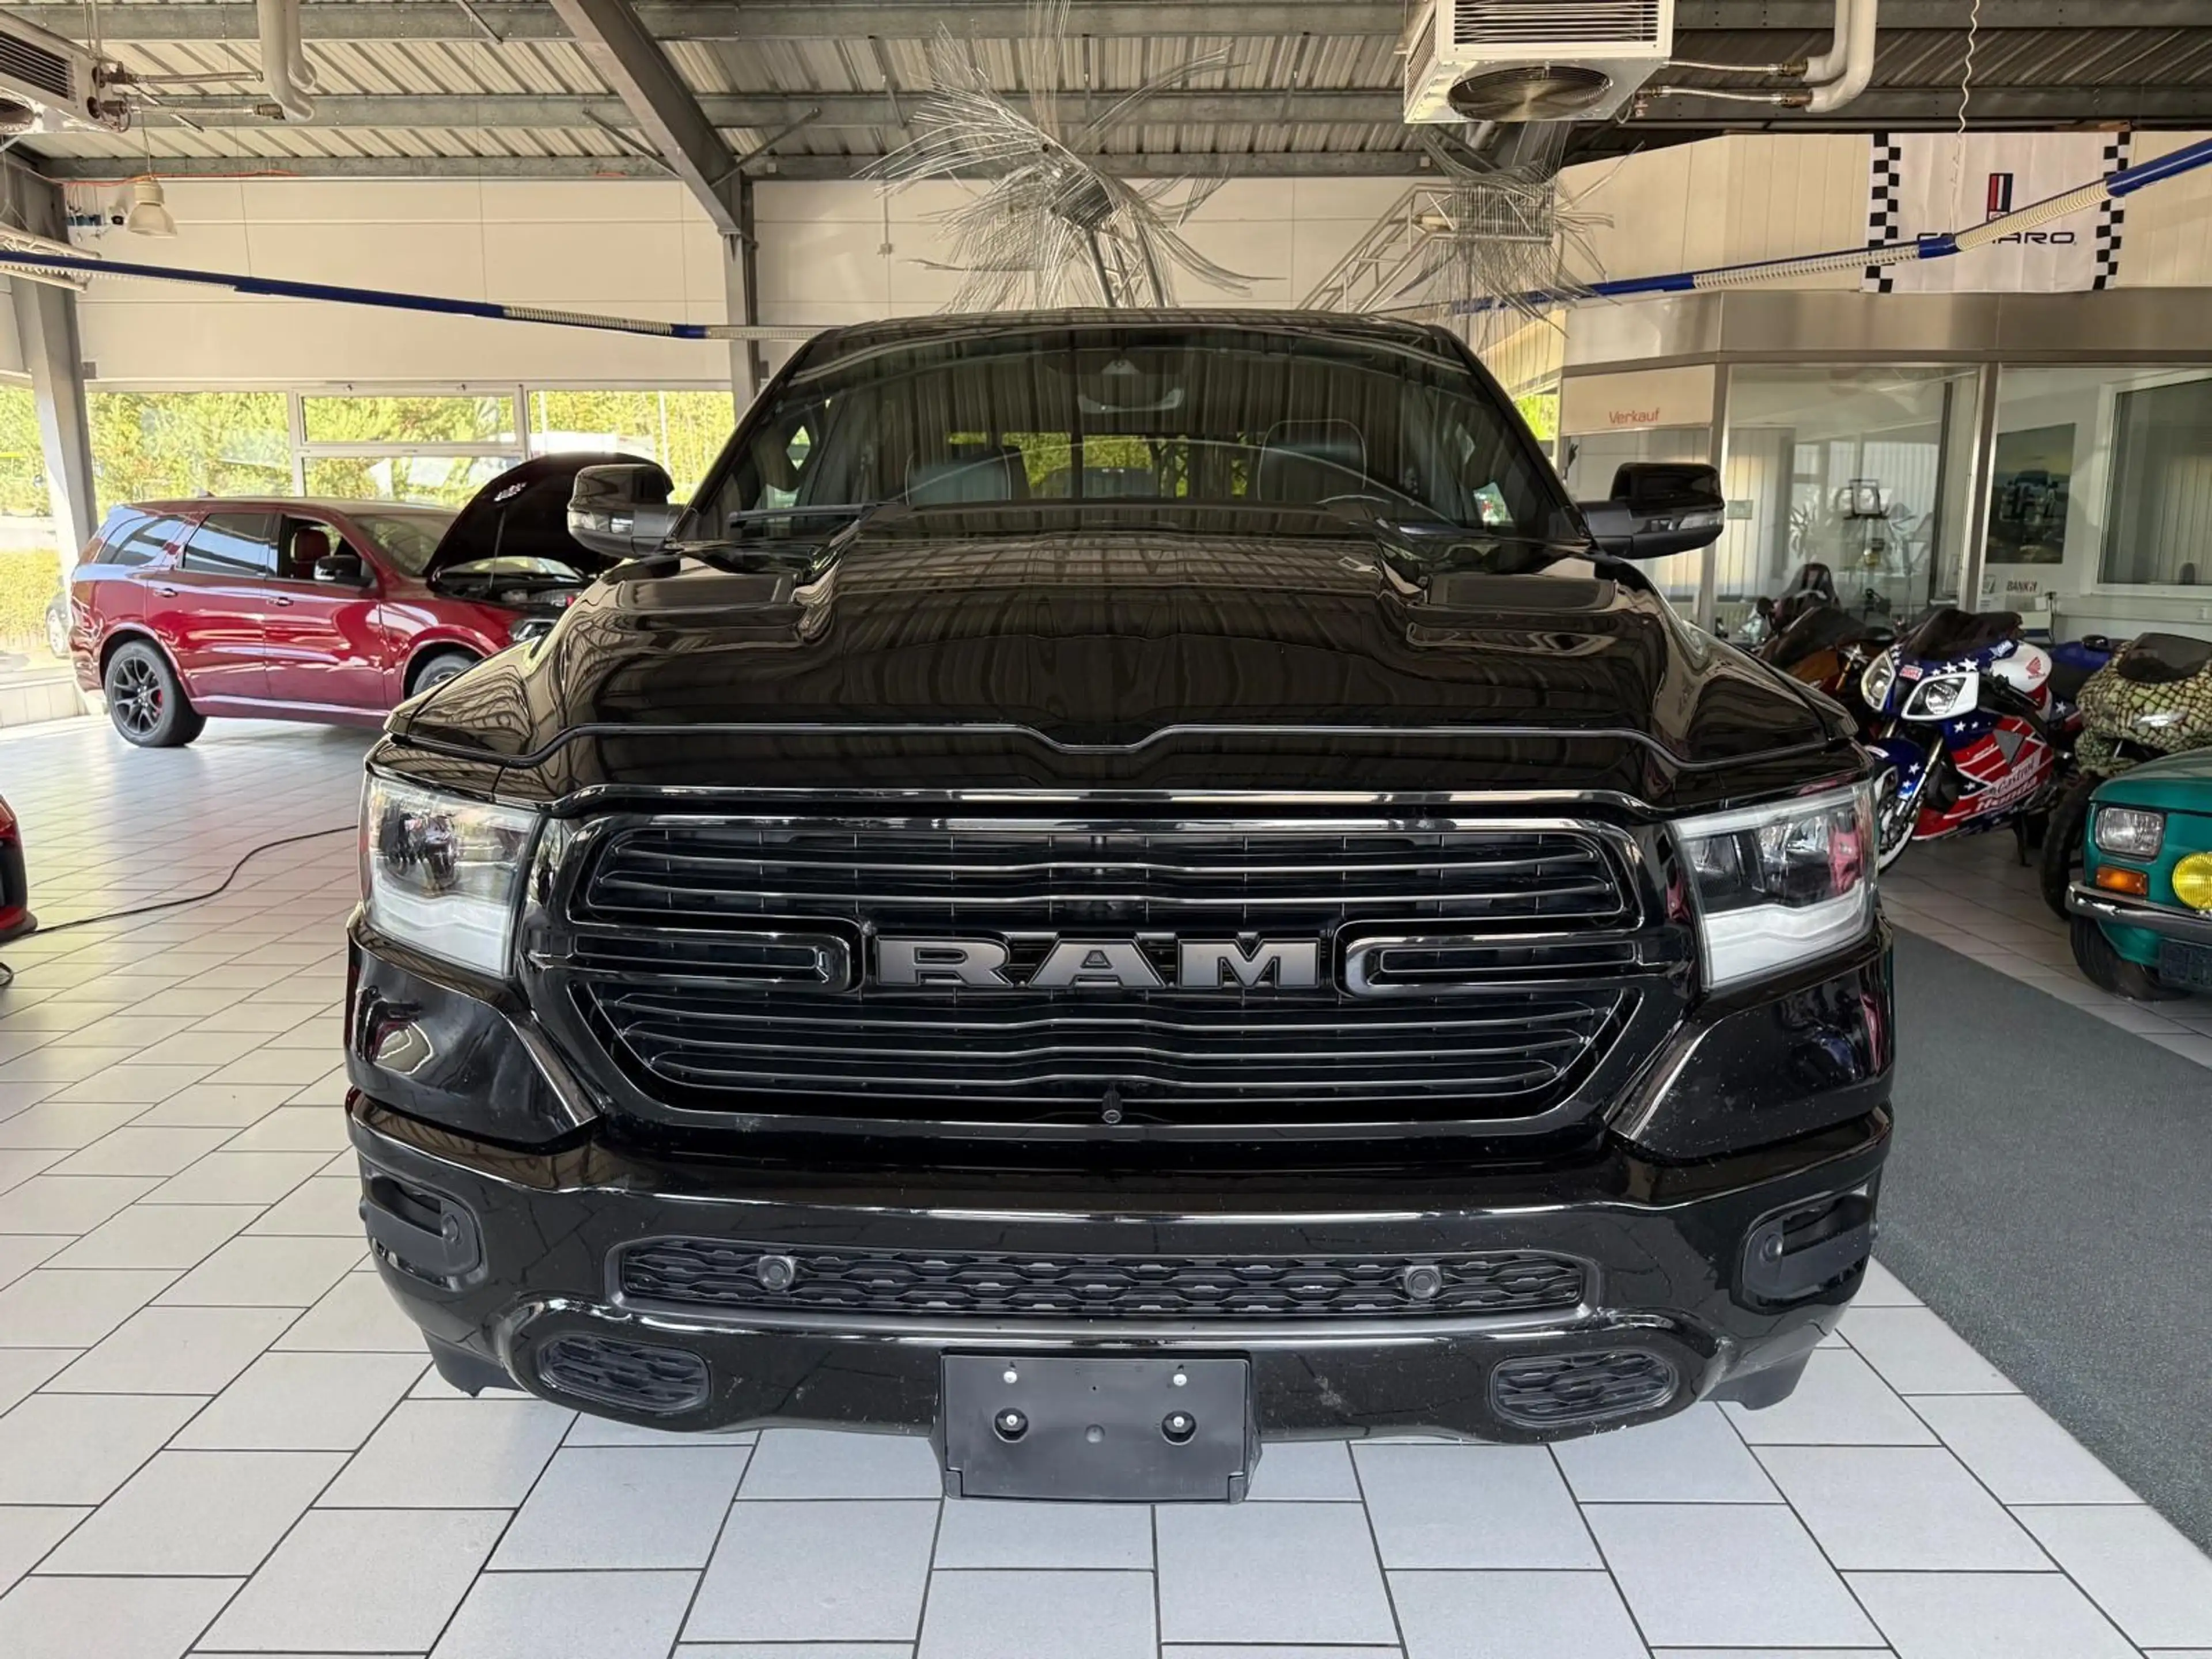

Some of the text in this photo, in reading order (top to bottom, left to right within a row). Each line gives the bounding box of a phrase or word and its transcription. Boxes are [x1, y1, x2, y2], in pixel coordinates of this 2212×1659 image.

[1916, 232, 2074, 244] CARO
[1609, 407, 1660, 424] Verkauf
[874, 932, 1321, 990] RAM
